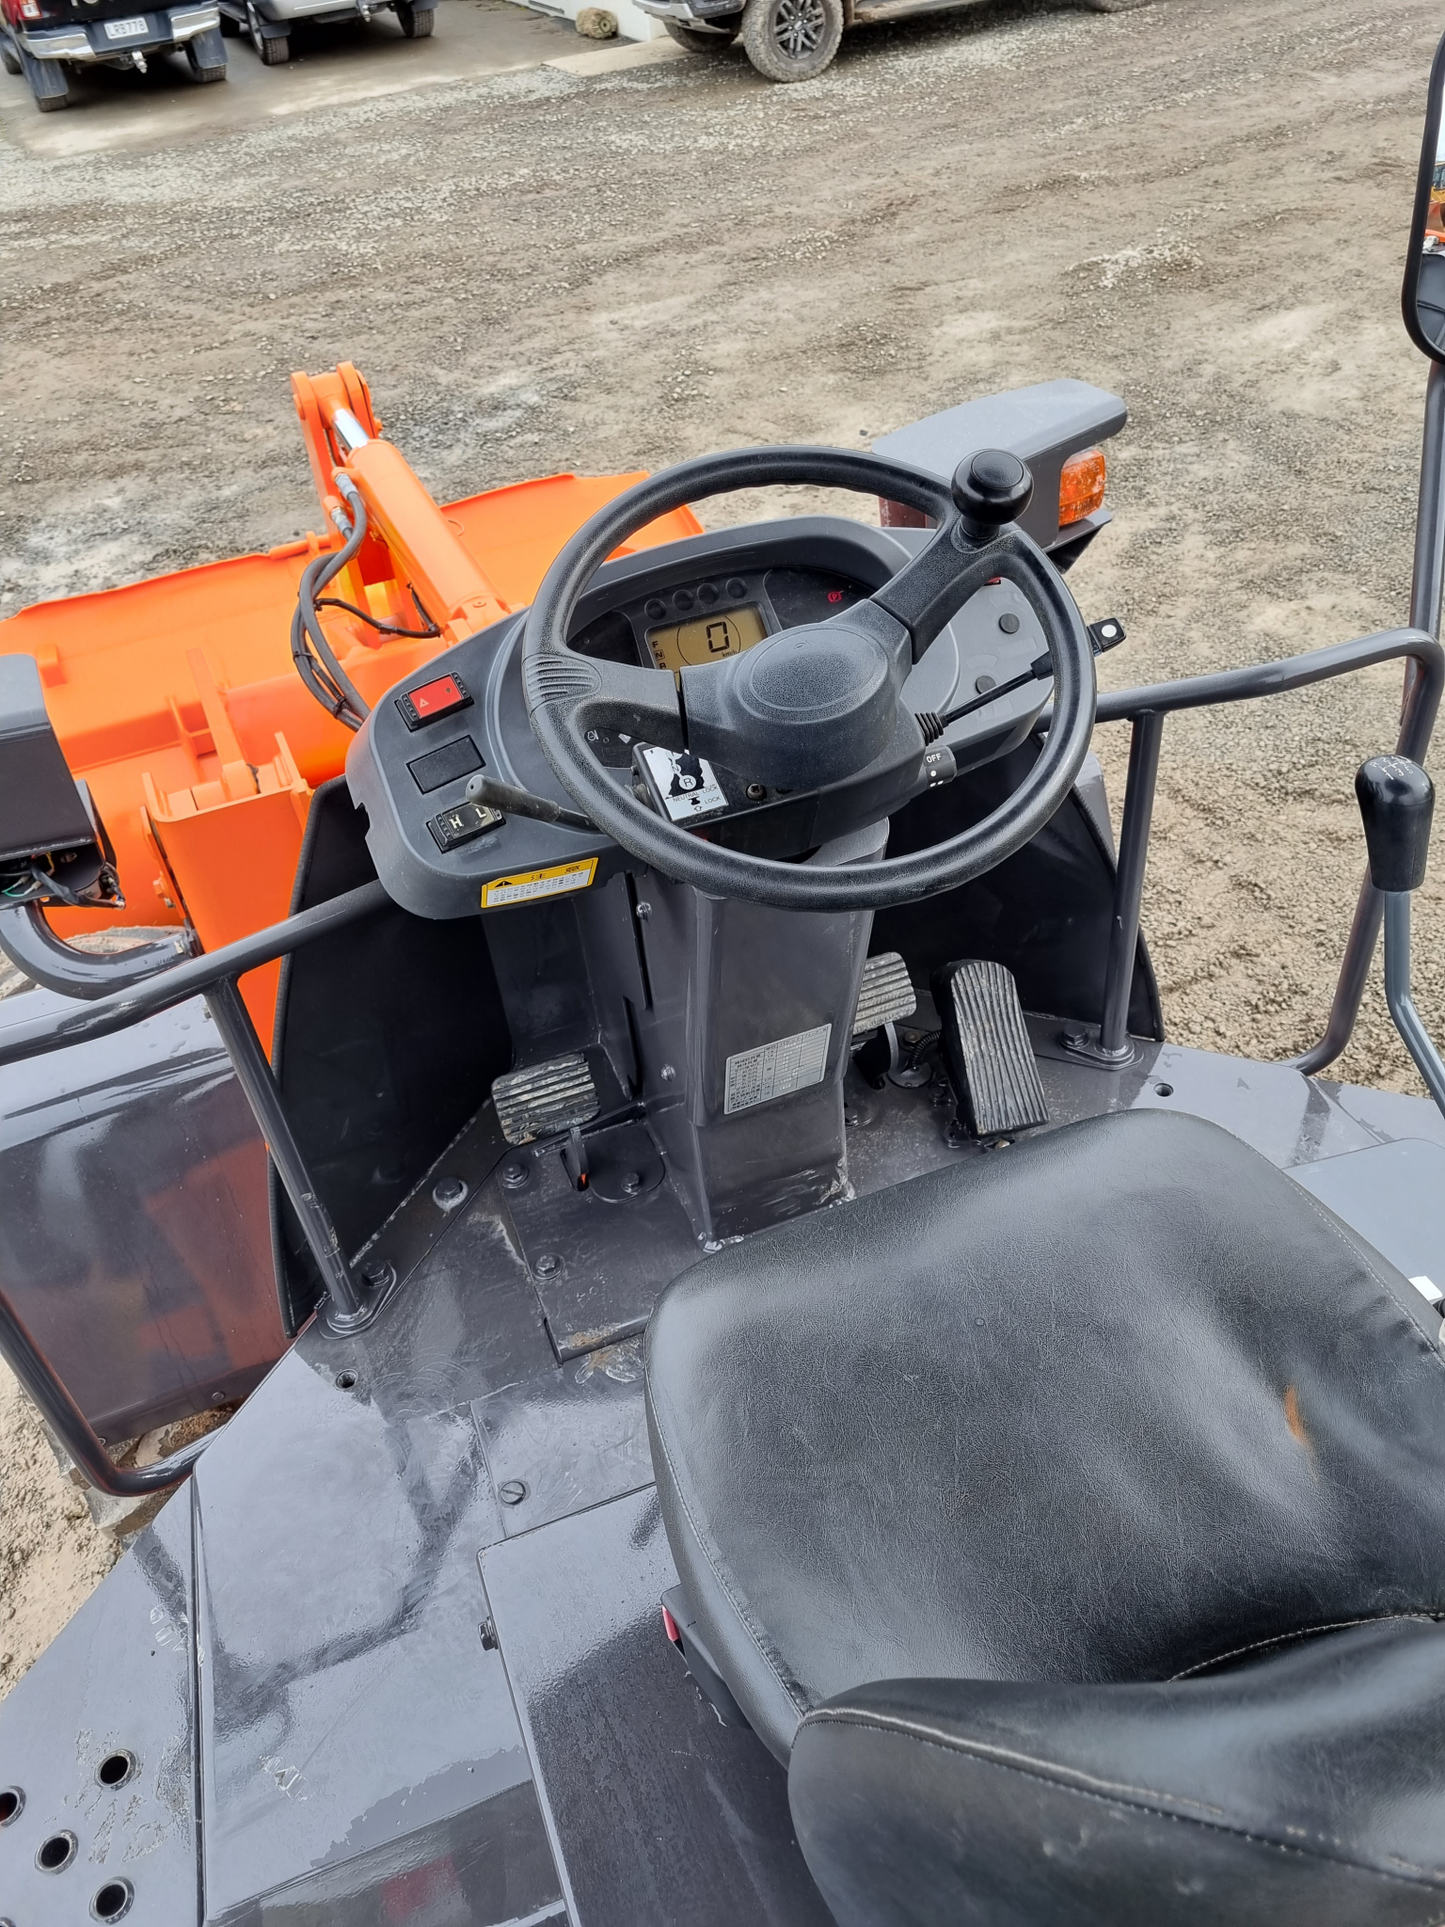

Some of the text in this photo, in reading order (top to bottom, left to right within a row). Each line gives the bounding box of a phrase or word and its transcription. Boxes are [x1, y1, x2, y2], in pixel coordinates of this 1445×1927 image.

[706, 621, 730, 653] 0
[655, 651, 663, 659] N
[926, 753, 941, 763] OFF
[1385, 772, 1394, 780] 1
[1395, 768, 1404, 777] 3
[683, 777, 694, 788] R
[672, 784, 719, 802] NEUTRAL LOCK
[704, 796, 721, 805] LOCK
[475, 807, 487, 819] L
[449, 814, 465, 829] H
